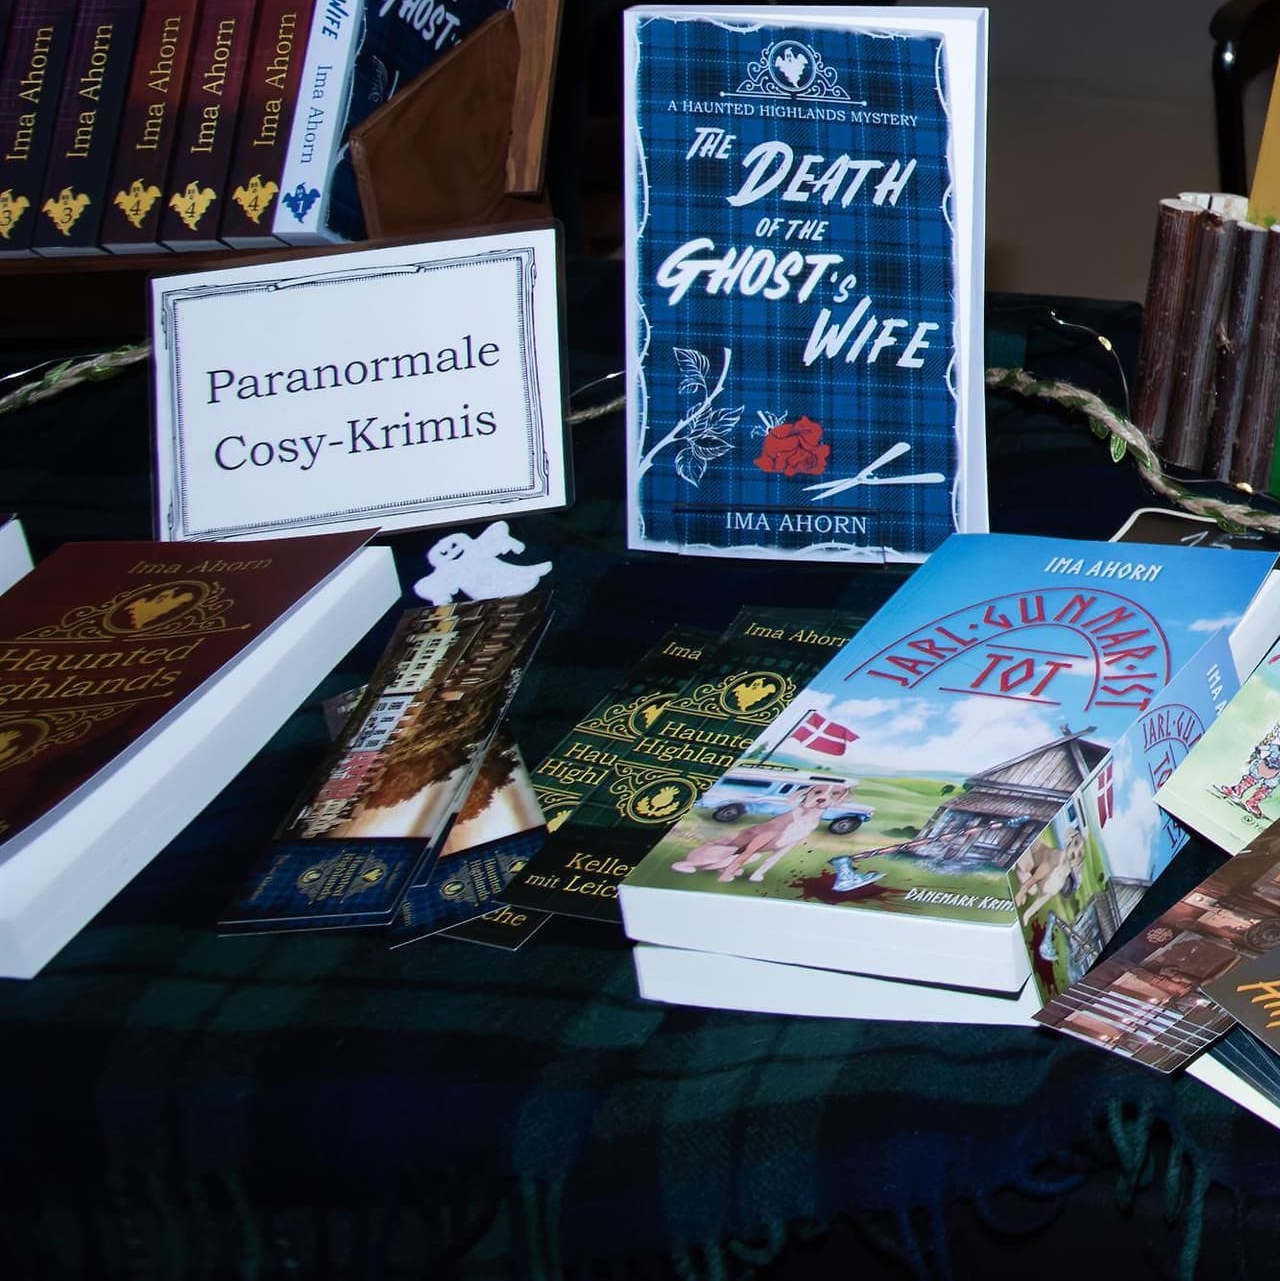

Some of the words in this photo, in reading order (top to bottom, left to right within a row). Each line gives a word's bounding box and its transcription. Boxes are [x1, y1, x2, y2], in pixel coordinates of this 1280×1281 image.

[18, 26, 54, 103] Ahorn
[78, 23, 113, 102] Ahorn
[148, 16, 181, 94] Ahorn
[265, 13, 297, 89] Ahorn
[312, 63, 332, 99] Ima
[66, 110, 96, 158] Ima
[136, 102, 166, 151] Ima
[254, 98, 282, 146] Ima
[300, 106, 325, 164] Ahorn
[668, 100, 678, 111] A
[682, 102, 754, 115] HAUNTED
[759, 106, 846, 122] HIGHLANDS
[851, 112, 918, 128] MYSTERY
[6, 112, 37, 161] Ima
[685, 127, 737, 161] THE
[726, 140, 917, 208] DEATH
[755, 217, 782, 238] OF
[784, 218, 829, 242] THE
[802, 296, 939, 368] WIFE
[206, 335, 500, 404] Paranormale
[214, 404, 497, 471] Cosy-Krimis
[726, 512, 770, 532] IMA
[780, 514, 868, 535] AHORN
[128, 560, 184, 575] Ima
[187, 558, 272, 574] Ahorn
[1044, 557, 1082, 576] IMA
[1086, 560, 1163, 582] AHORN
[662, 641, 704, 661] Ima
[744, 622, 784, 640] Ima
[0, 638, 205, 672] Haunted
[970, 653, 1073, 697] TOT
[0, 667, 182, 706] ghlands
[658, 720, 755, 750] Haunte
[525, 873, 557, 889] mit
